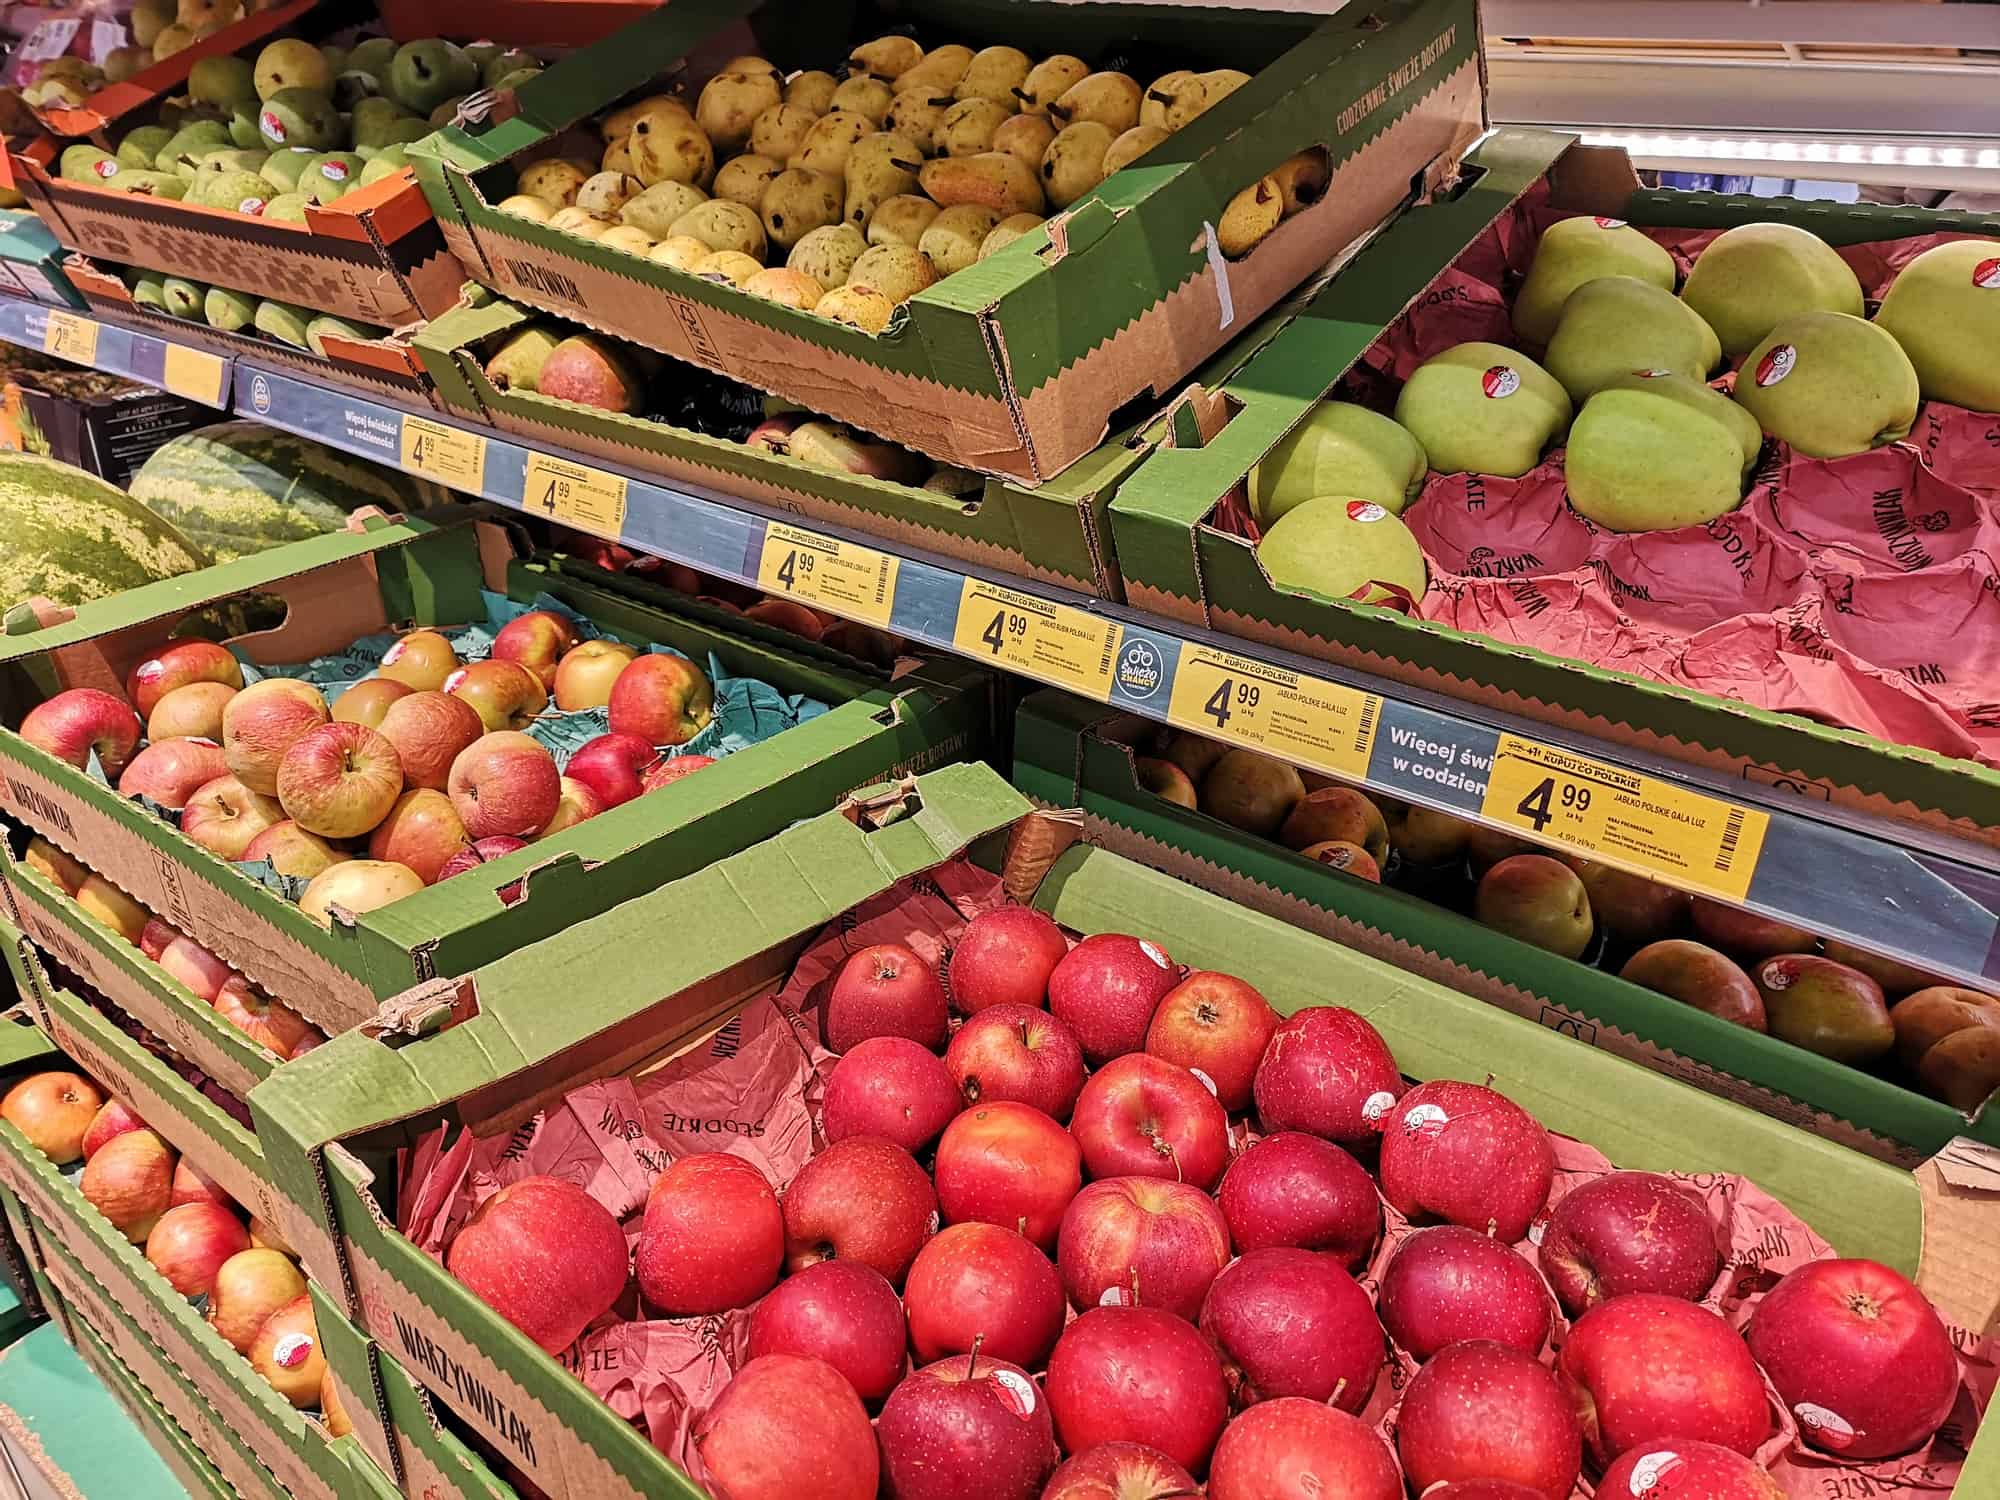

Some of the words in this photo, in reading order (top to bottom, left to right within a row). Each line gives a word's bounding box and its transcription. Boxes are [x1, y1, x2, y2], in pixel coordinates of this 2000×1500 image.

[1421, 23, 1456, 71] DOSTAWY
[413, 434, 424, 468] 4
[543, 480, 556, 514] 4
[558, 482, 570, 498] 99
[777, 550, 796, 591] 4
[799, 552, 815, 572] 99
[983, 610, 1006, 655] 4
[1008, 614, 1027, 636] 99
[1224, 657, 1249, 672] KUPUJ
[1249, 665, 1261, 674] CO
[1262, 668, 1298, 685] POLSKIE!
[1204, 678, 1233, 729] 4
[1237, 683, 1260, 707] 99
[1298, 694, 1321, 708] POLSKIE
[1336, 705, 1348, 716] LUZ
[1391, 726, 1457, 765] Więcej
[1393, 757, 1409, 772] w
[1543, 755, 1577, 772] KUPUJ
[1577, 764, 1593, 775] CO
[1594, 769, 1641, 791] POLSKIE!
[1517, 778, 1556, 833] 4
[1561, 784, 1591, 811] 99
[1575, 813, 1584, 823] kg
[1614, 792, 1641, 807] JABŁKO
[1641, 800, 1670, 818] POLSKIE
[1671, 809, 1691, 823] GALA
[1691, 816, 1706, 828] LUZ
[393, 1312, 537, 1468] WARZYWNIAK
